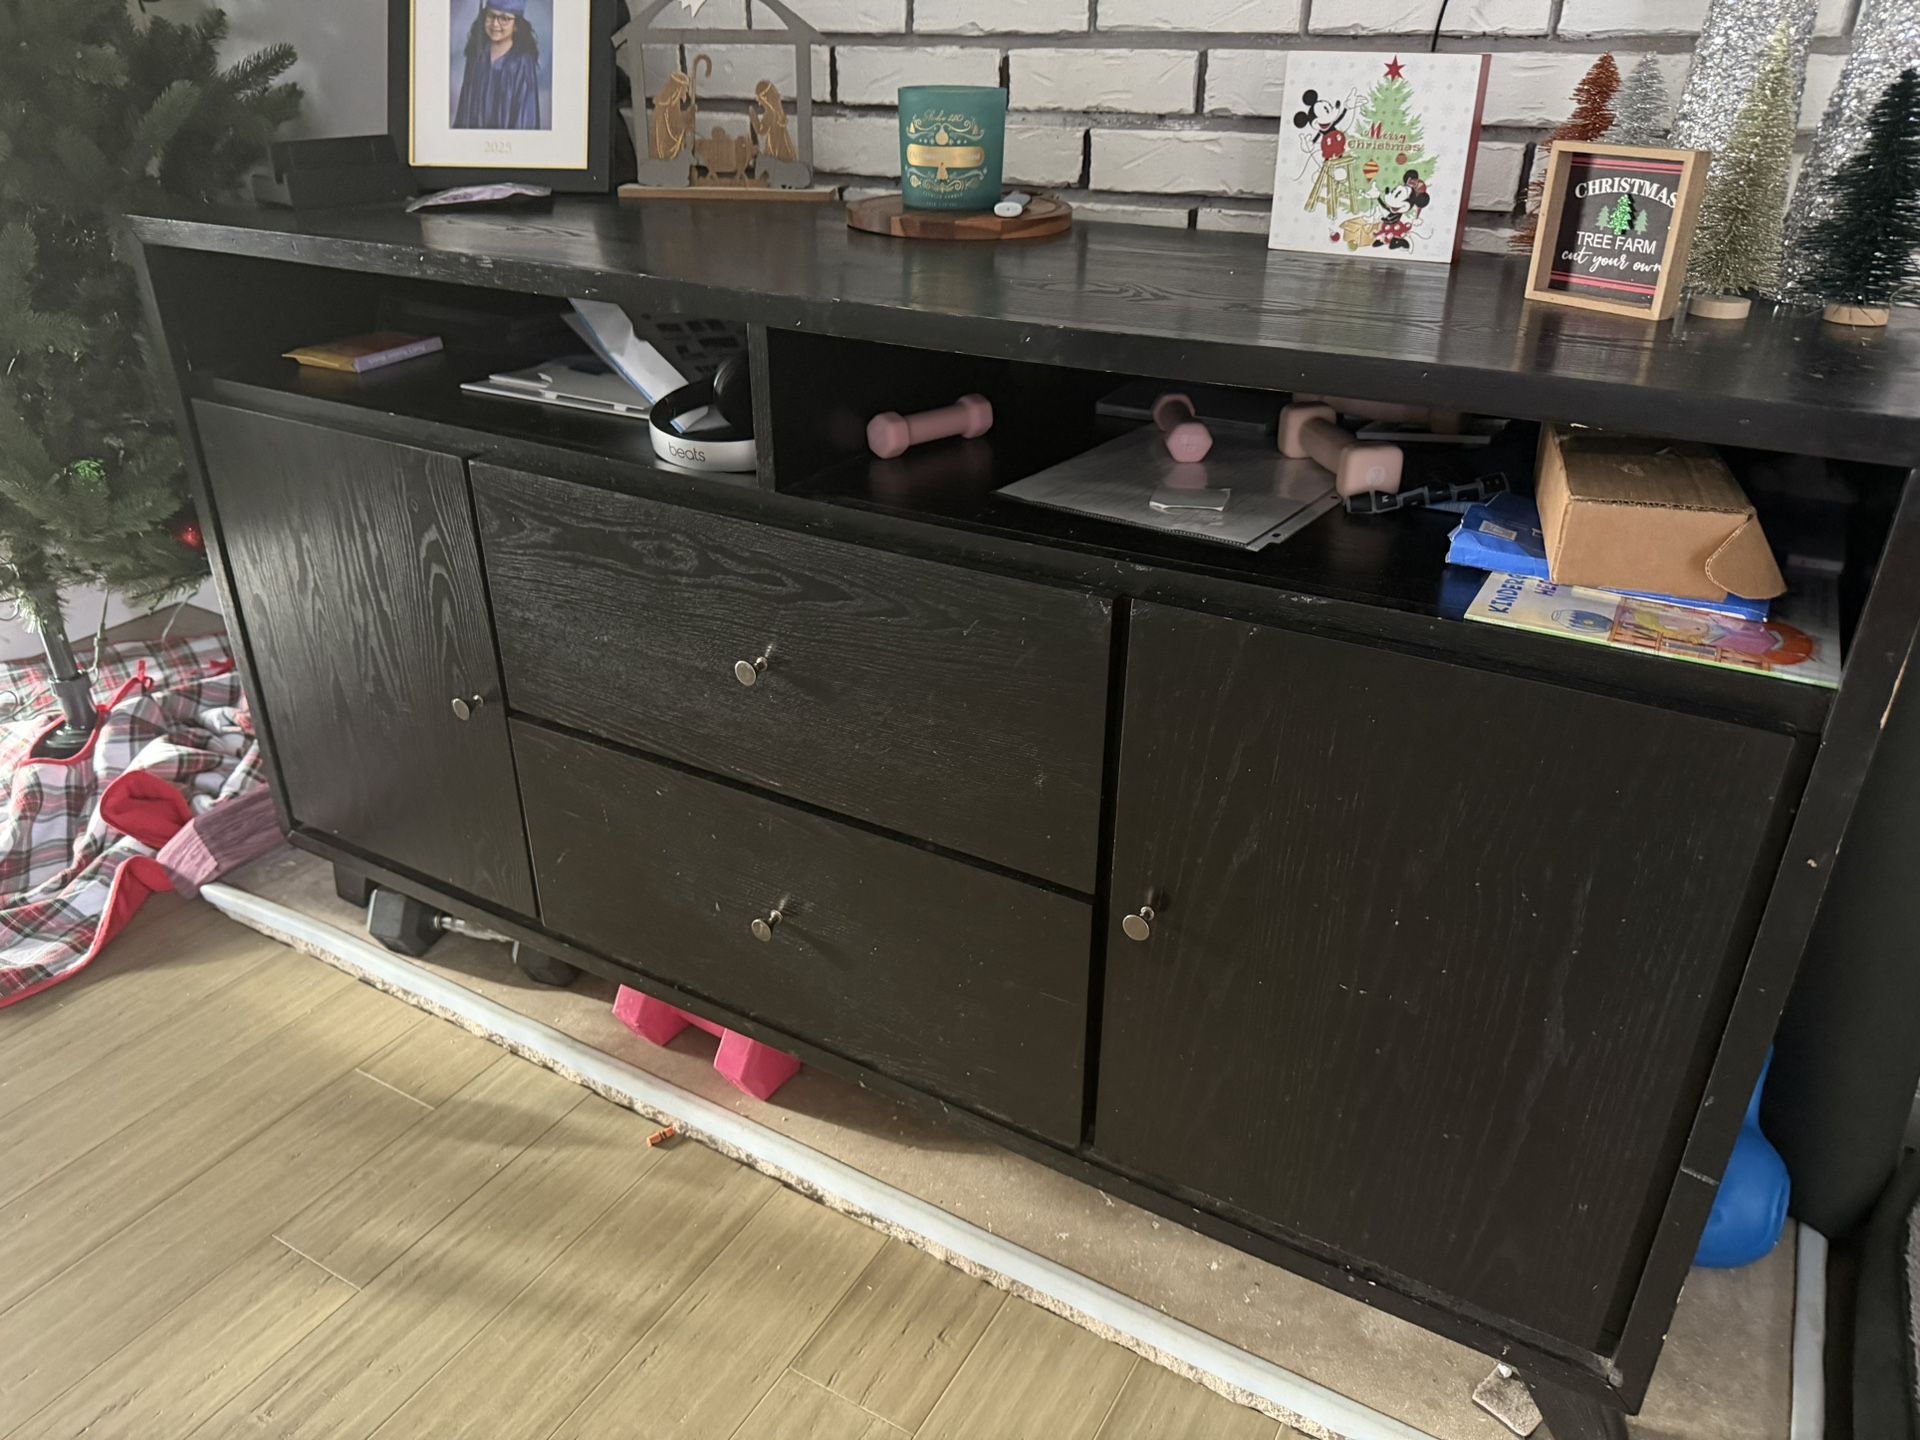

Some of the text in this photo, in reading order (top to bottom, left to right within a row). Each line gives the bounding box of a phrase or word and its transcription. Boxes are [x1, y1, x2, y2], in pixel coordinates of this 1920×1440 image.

[1360, 121, 1407, 143] Merry
[484, 141, 513, 153] 2025
[1347, 139, 1422, 152] Christmas
[1575, 177, 1678, 208] CHRISTMAS
[1577, 231, 1657, 255] TREE FARM
[1561, 247, 1592, 263] cut
[1592, 254, 1629, 272] your
[668, 442, 706, 462] beats
